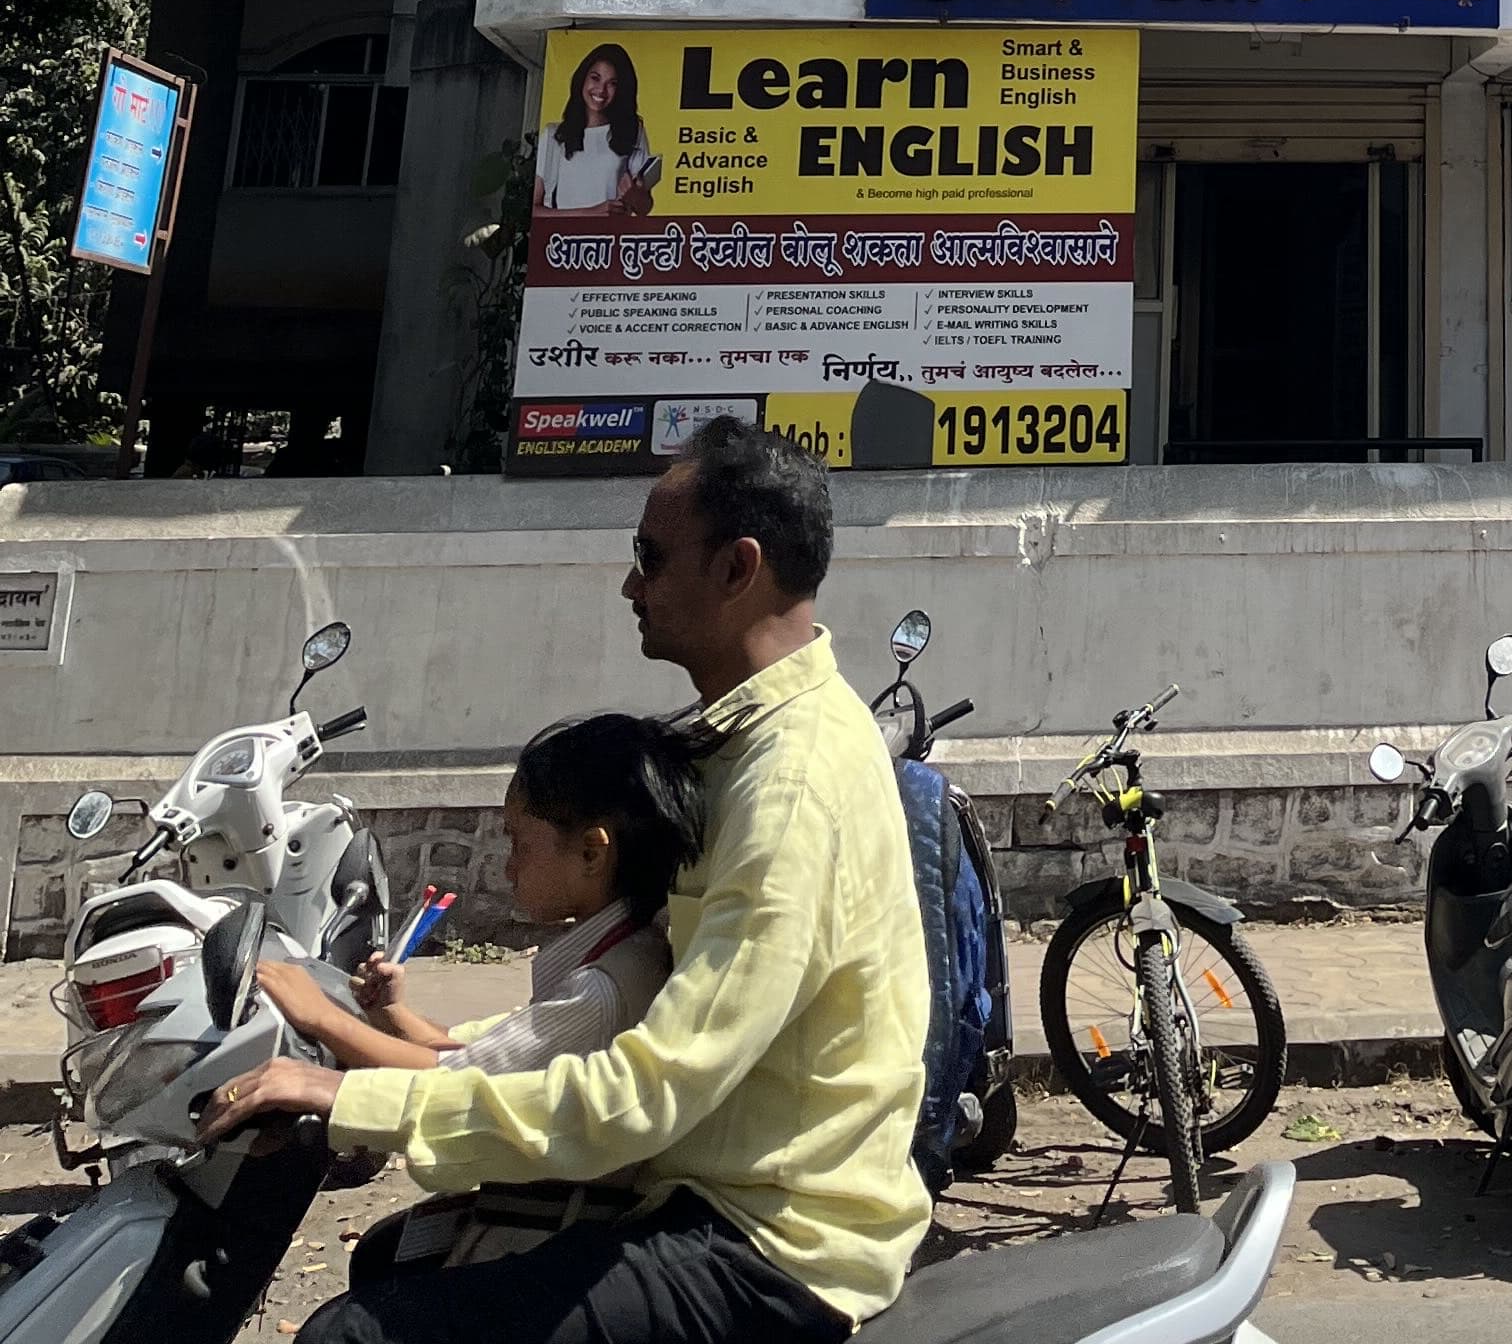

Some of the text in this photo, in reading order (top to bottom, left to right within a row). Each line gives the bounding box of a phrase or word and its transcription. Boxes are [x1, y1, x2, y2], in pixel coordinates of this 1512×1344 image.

[1002, 39, 1084, 57] Smart &
[679, 46, 968, 110] Learn
[1002, 64, 1096, 81] Business
[1001, 88, 1077, 109] English
[678, 126, 758, 144] Basic &
[798, 125, 1093, 177] ENGLISH
[675, 151, 768, 170] Advance
[674, 176, 754, 198] English
[867, 188, 912, 199] Become
[916, 188, 937, 201] high
[940, 187, 964, 201] paid
[546, 218, 1121, 280] आता तुम्ही देखील बोलू शकता आत्मविश्वासाने
[582, 291, 697, 302] EFFECTIVE SPEAKING
[767, 289, 886, 300] PRESENTATION SKILLS
[938, 289, 1033, 299] INTERVIEW SKILLS
[580, 307, 718, 318] PUBLIC SPEAKING SKILLS
[766, 305, 882, 316] PERSONAL COACHING
[937, 304, 1089, 314] PERSONALITY DEVELOPMENT
[579, 322, 742, 333] VOICE & ACCENT CORRECTION
[765, 320, 909, 331] BASIC & ADVANCE ENGLISH
[937, 319, 1058, 330] E-MAIL WRITING SKILLS
[934, 336, 966, 346] IELTS
[973, 335, 1009, 345] TOEFL
[1011, 335, 1062, 345] TRAINING
[529, 339, 599, 368] उशीर
[719, 350, 772, 369] तुमचा
[778, 349, 810, 365] एक
[972, 363, 1034, 383] आयुष्य
[524, 409, 632, 431] Speakwell
[936, 405, 1120, 457] 1913204
[517, 439, 642, 456] ENGLISH ACADEMY
